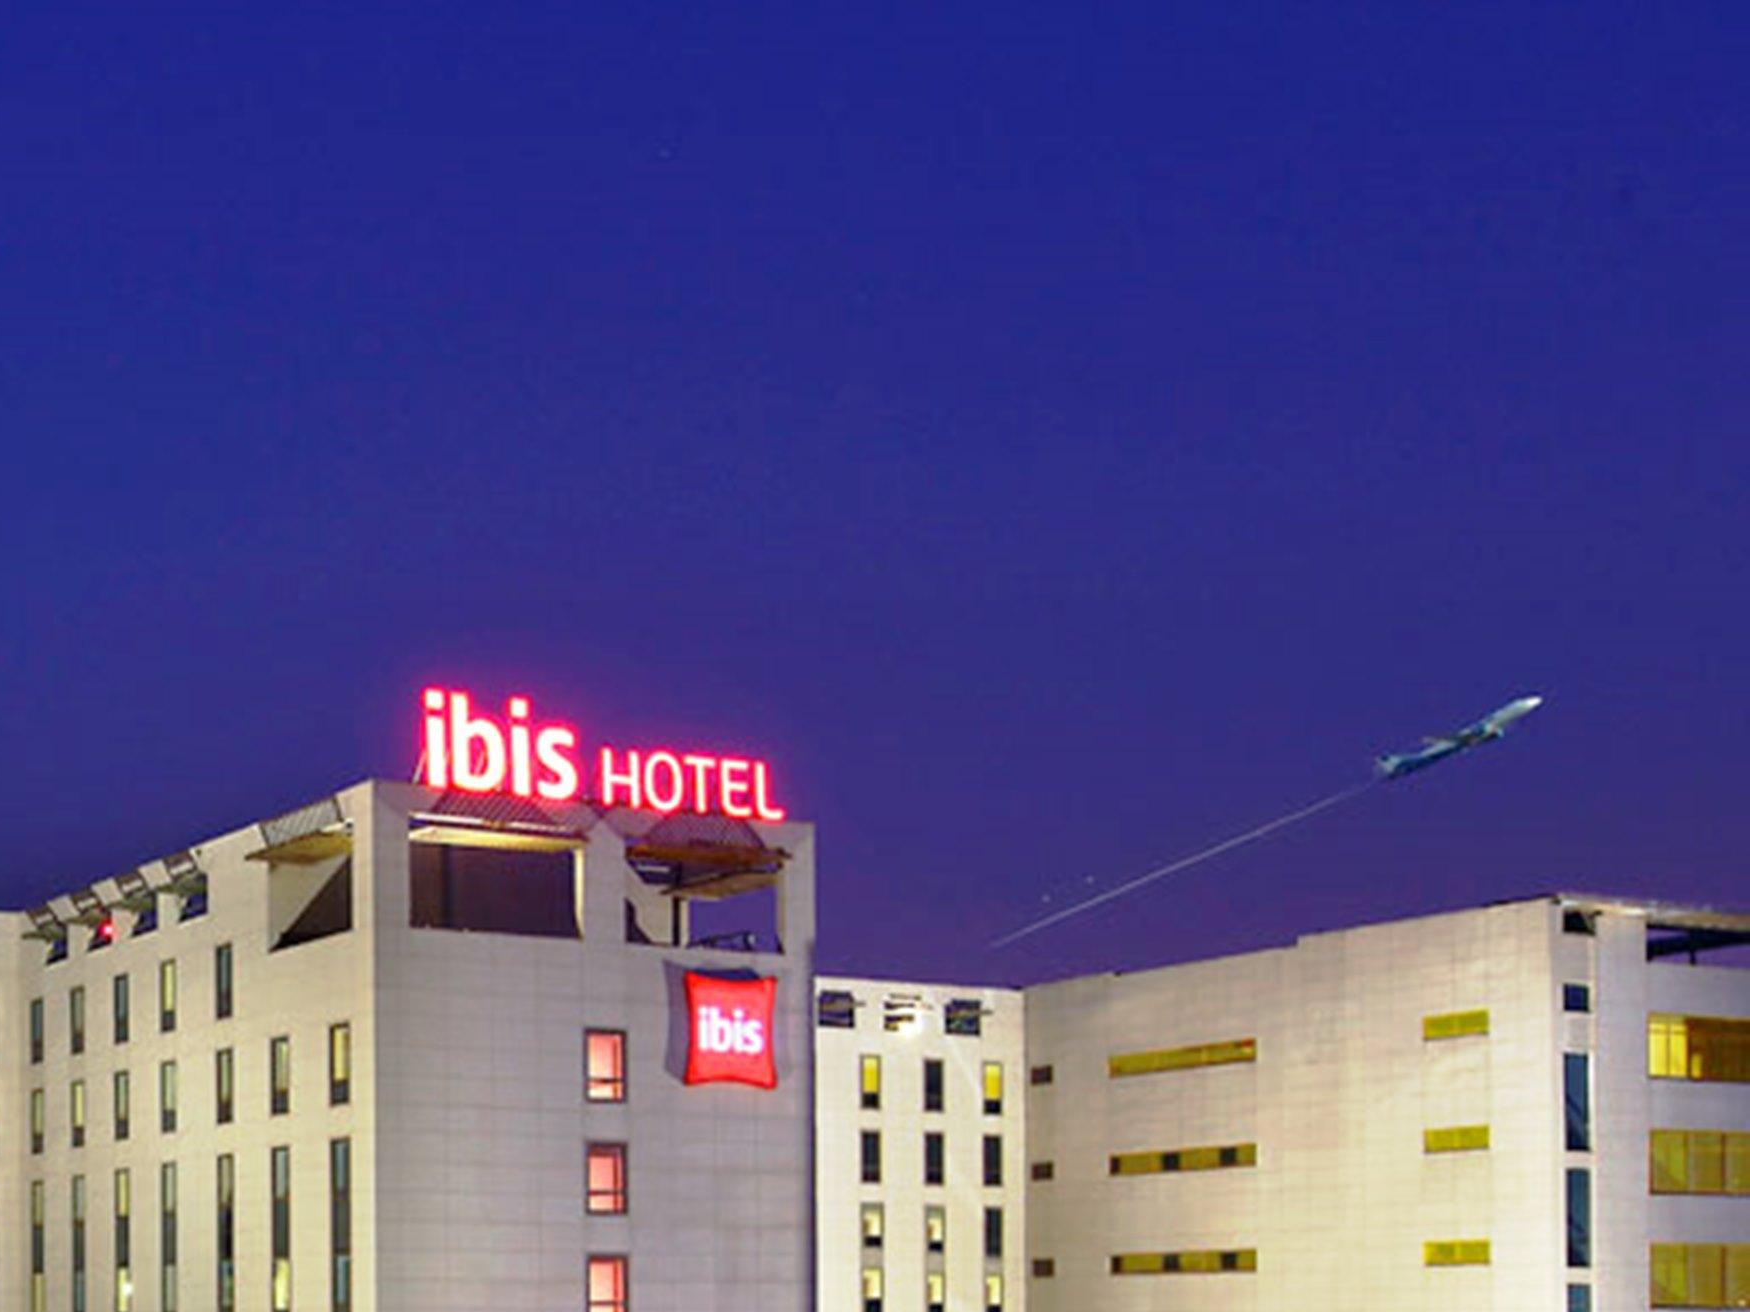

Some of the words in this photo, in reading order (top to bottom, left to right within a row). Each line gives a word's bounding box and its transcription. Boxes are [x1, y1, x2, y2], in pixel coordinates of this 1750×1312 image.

[423, 687, 580, 800] ibis
[601, 746, 785, 821] HOTEL
[697, 1006, 764, 1055] ibis
